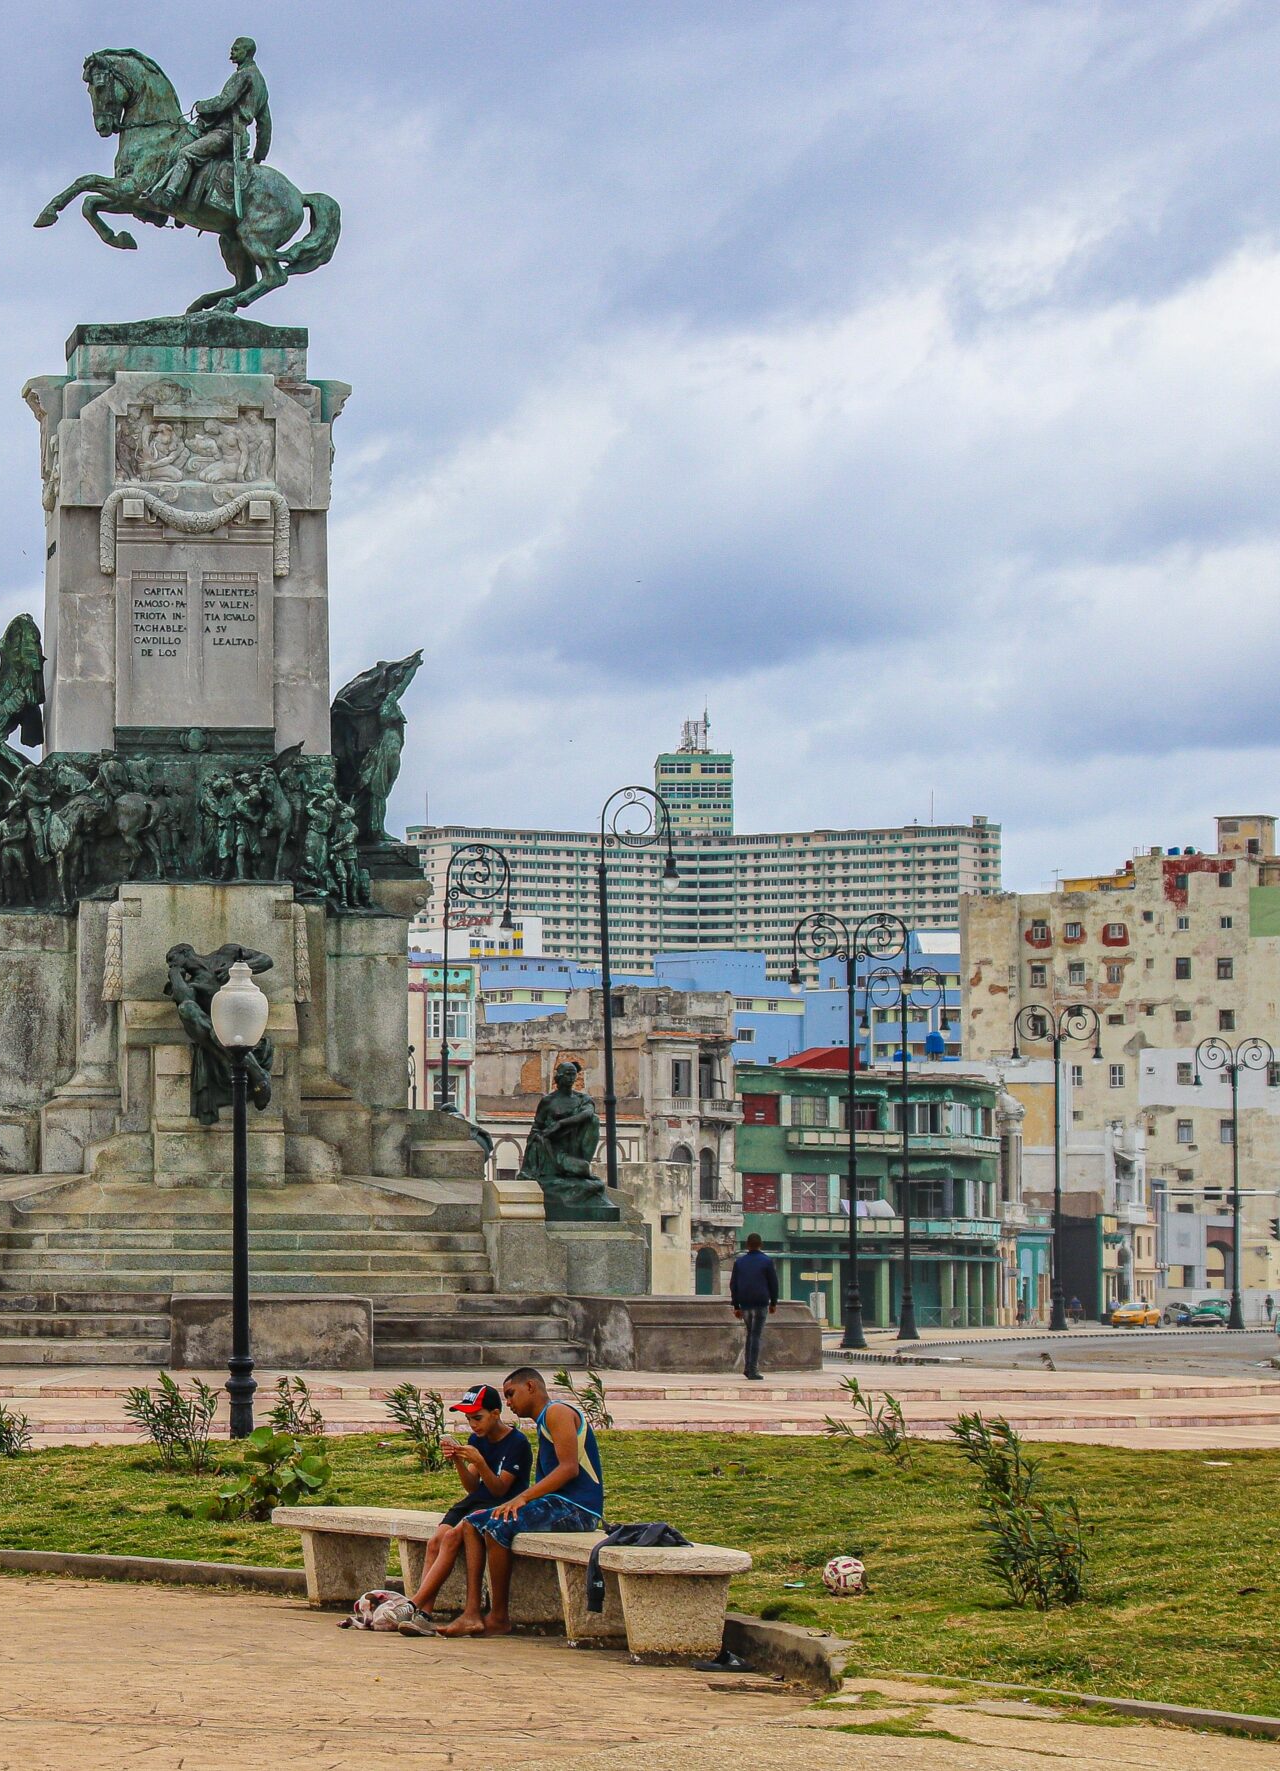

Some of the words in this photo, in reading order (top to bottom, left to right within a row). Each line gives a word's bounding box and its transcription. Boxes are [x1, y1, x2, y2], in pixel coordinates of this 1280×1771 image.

[143, 588, 183, 596] CAPITAN
[134, 612, 167, 621] TRIOTA
[204, 613, 220, 622] TIA
[204, 625, 211, 633] A
[141, 648, 153, 657] DE
[158, 648, 177, 657] LOS
